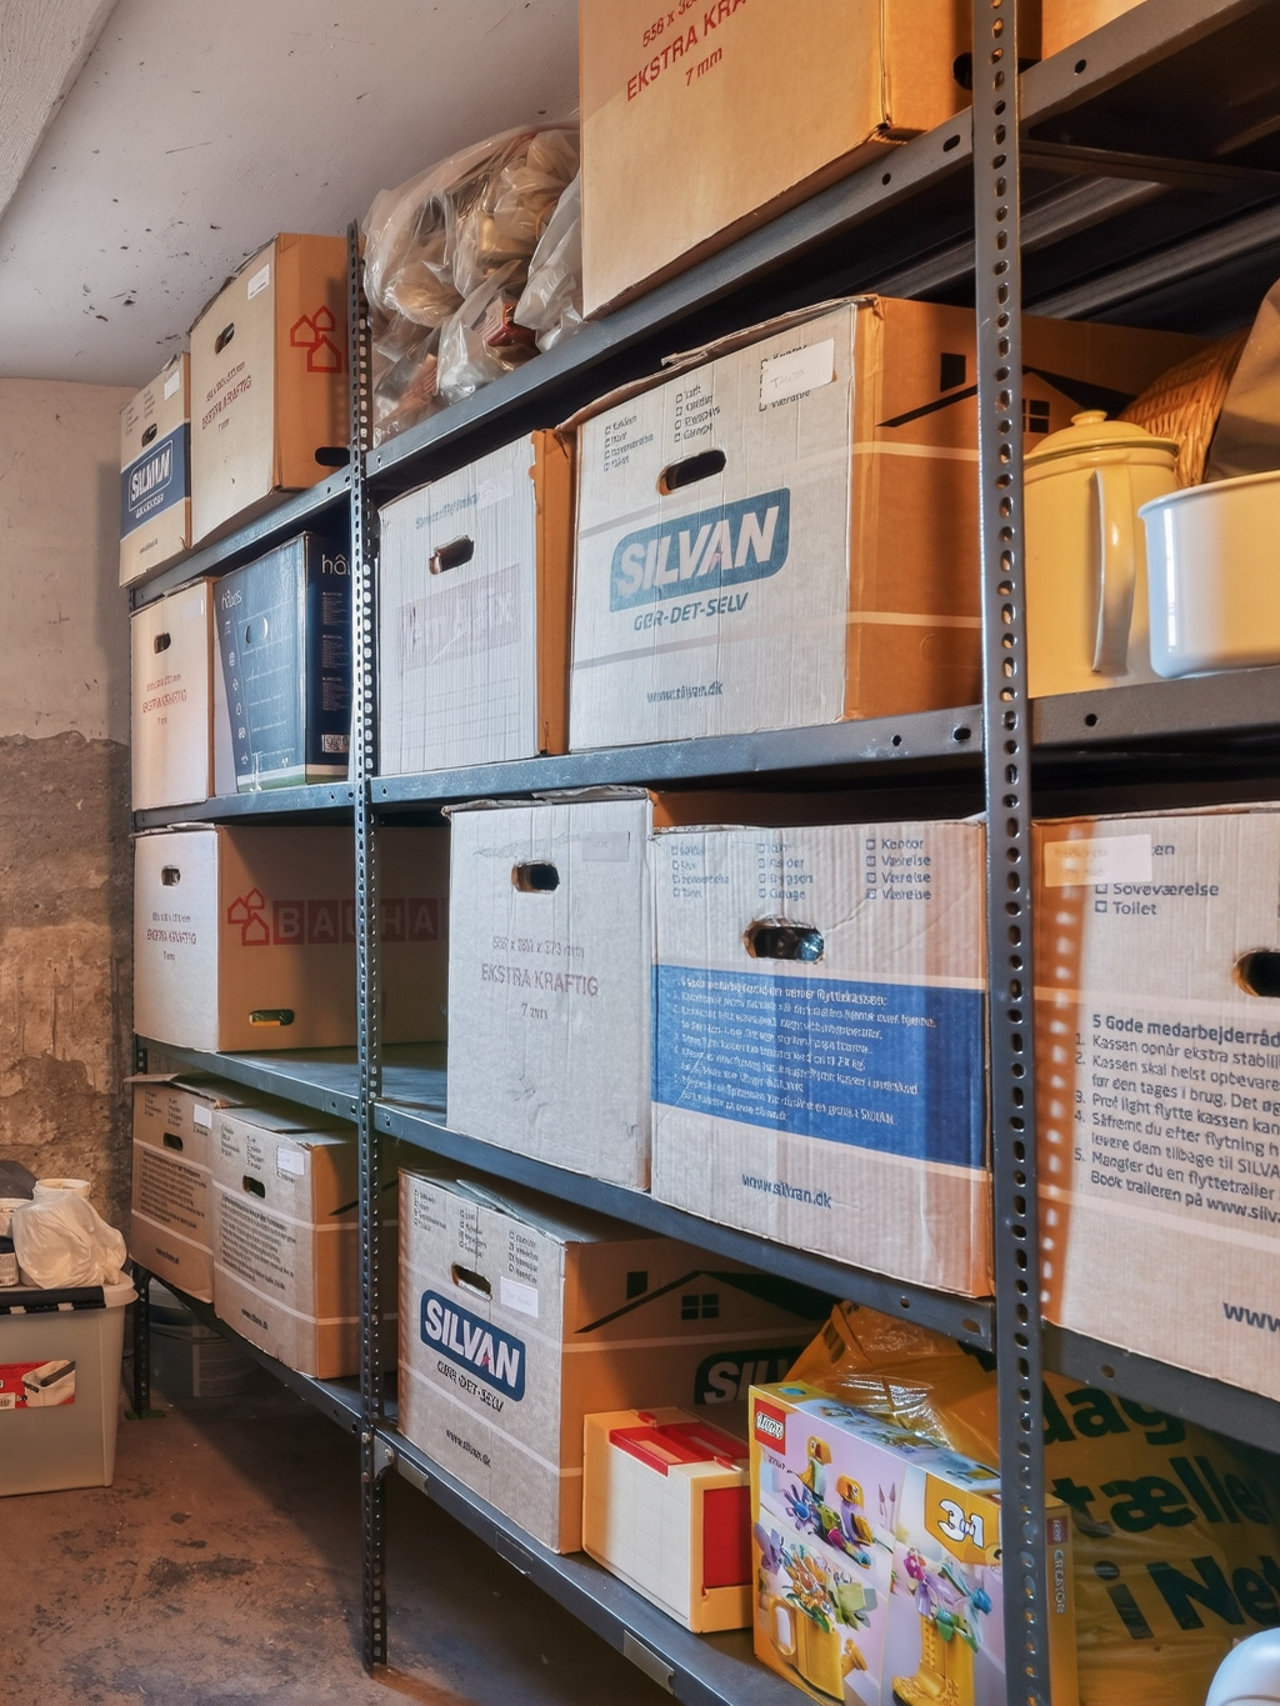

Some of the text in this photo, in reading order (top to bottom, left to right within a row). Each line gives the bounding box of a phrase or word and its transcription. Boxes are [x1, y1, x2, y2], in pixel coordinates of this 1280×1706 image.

[626, 25, 699, 102] EKSTRA
[685, 47, 723, 87] 7 mm
[617, 505, 780, 598] SILVAN
[1113, 881, 1219, 897] Soveværelse
[1112, 901, 1157, 916] Toilet
[481, 963, 599, 998] EKSTRA KRAFTIG
[1092, 1014, 1102, 1029] 5
[1105, 1015, 1144, 1034] Gode
[1092, 1034, 1138, 1053] Kassen
[1183, 1046, 1229, 1064] ekstra
[1232, 1052, 1280, 1070] stabili
[1092, 1055, 1138, 1072] Kassen
[1140, 1062, 1167, 1077] skal
[1170, 1063, 1207, 1082] helst
[1112, 1078, 1137, 1093] den
[1140, 1081, 1178, 1100] tages
[1230, 1093, 1259, 1111] Det
[1154, 1102, 1193, 1121] flytte
[1196, 1109, 1249, 1130] kassen
[1091, 1132, 1280, 1179] levere dem tilbage til SILVA
[1145, 1121, 1162, 1137] du
[1165, 1126, 1201, 1143] efter
[1204, 1131, 1265, 1158] flytning
[1091, 1151, 1144, 1173] Mangler
[1146, 1162, 1163, 1178] du
[1166, 1168, 1185, 1183] en
[1188, 1169, 1276, 1201] flyttetrailer
[1090, 1169, 1280, 1225] Book traileren på www.silva
[424, 1299, 521, 1389] SILVAN
